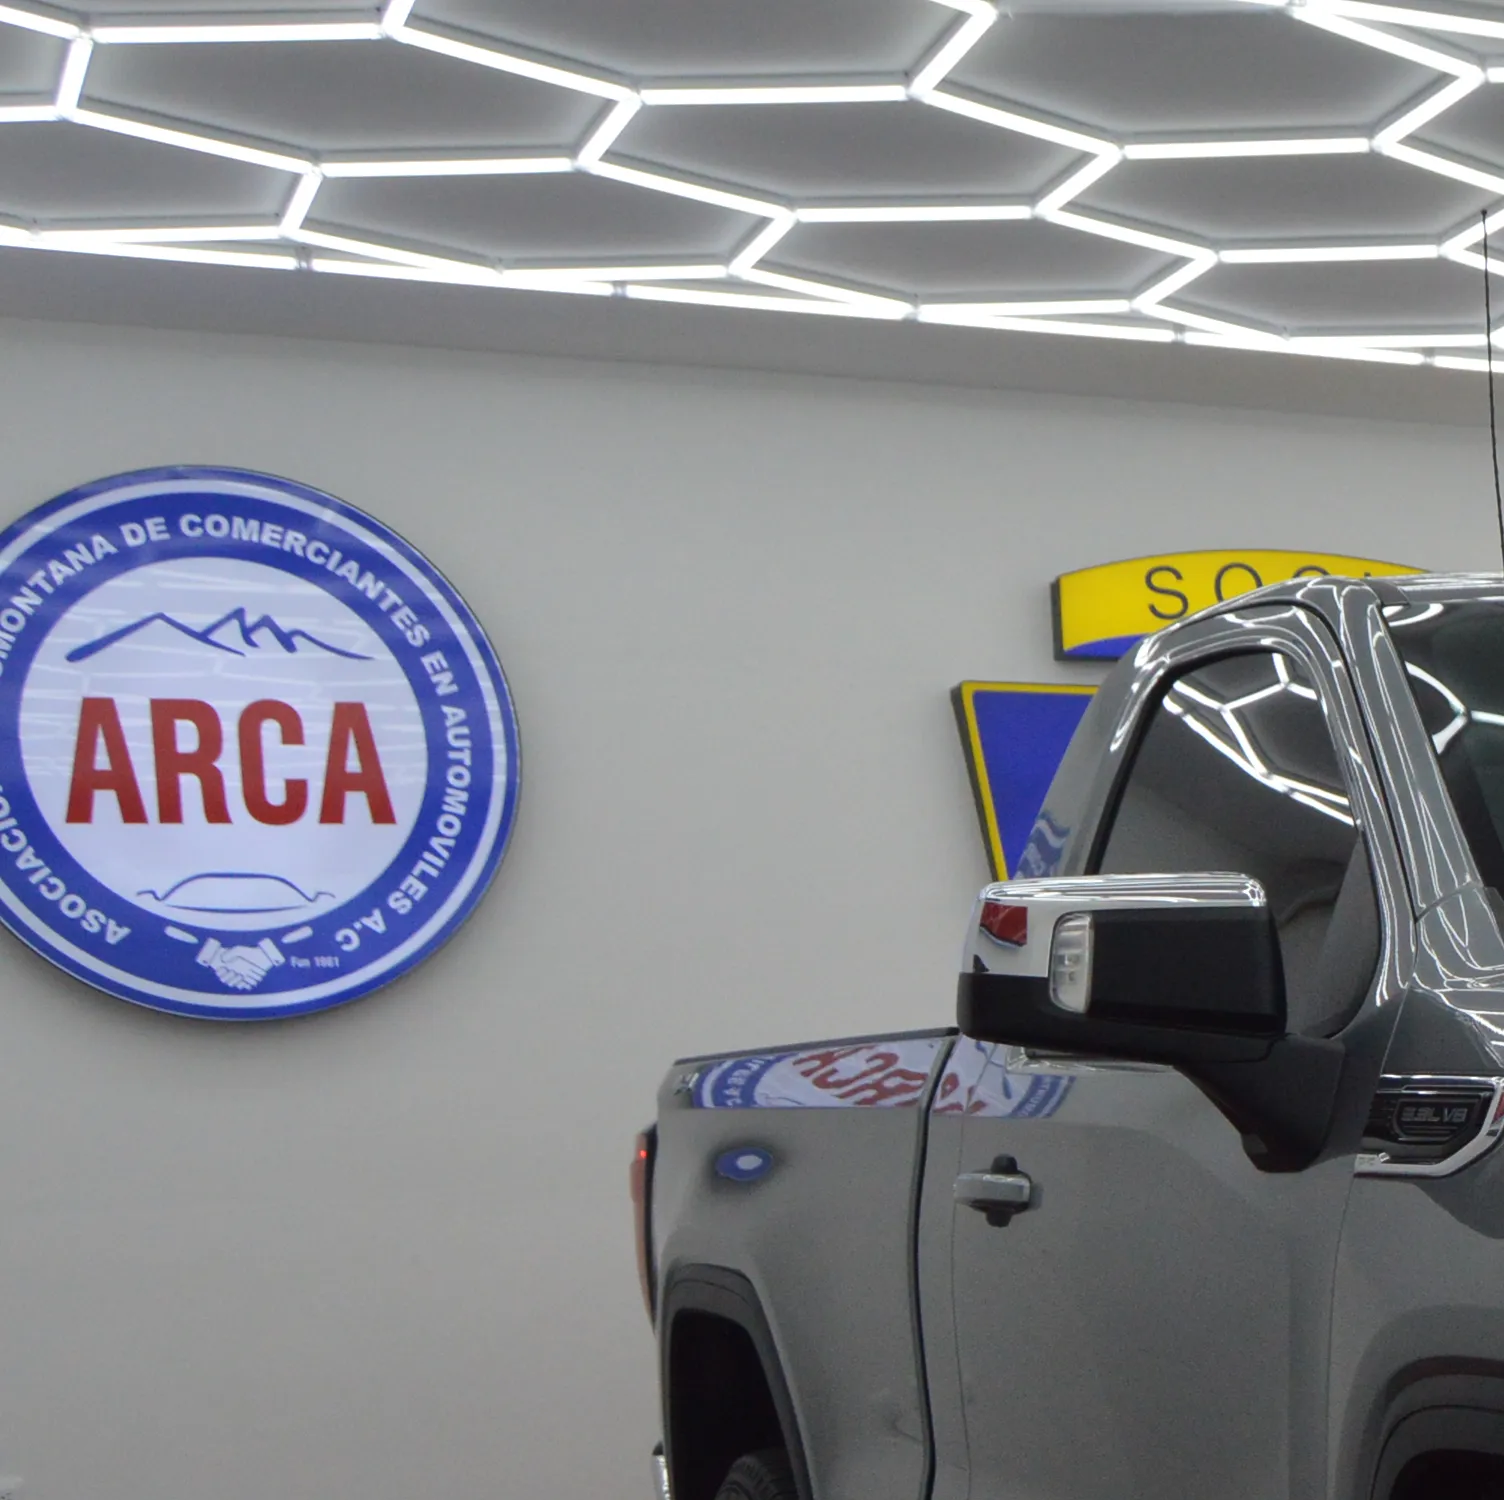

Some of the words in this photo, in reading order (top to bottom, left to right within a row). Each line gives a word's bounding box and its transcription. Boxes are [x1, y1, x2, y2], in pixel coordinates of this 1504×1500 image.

[120, 516, 171, 547] DE
[180, 514, 431, 648] COMERCIANTES
[420, 651, 459, 697] EN
[65, 697, 397, 826] ARCA
[387, 704, 472, 915] AUTOMOVILES
[0, 783, 131, 945] ASOCIACI
